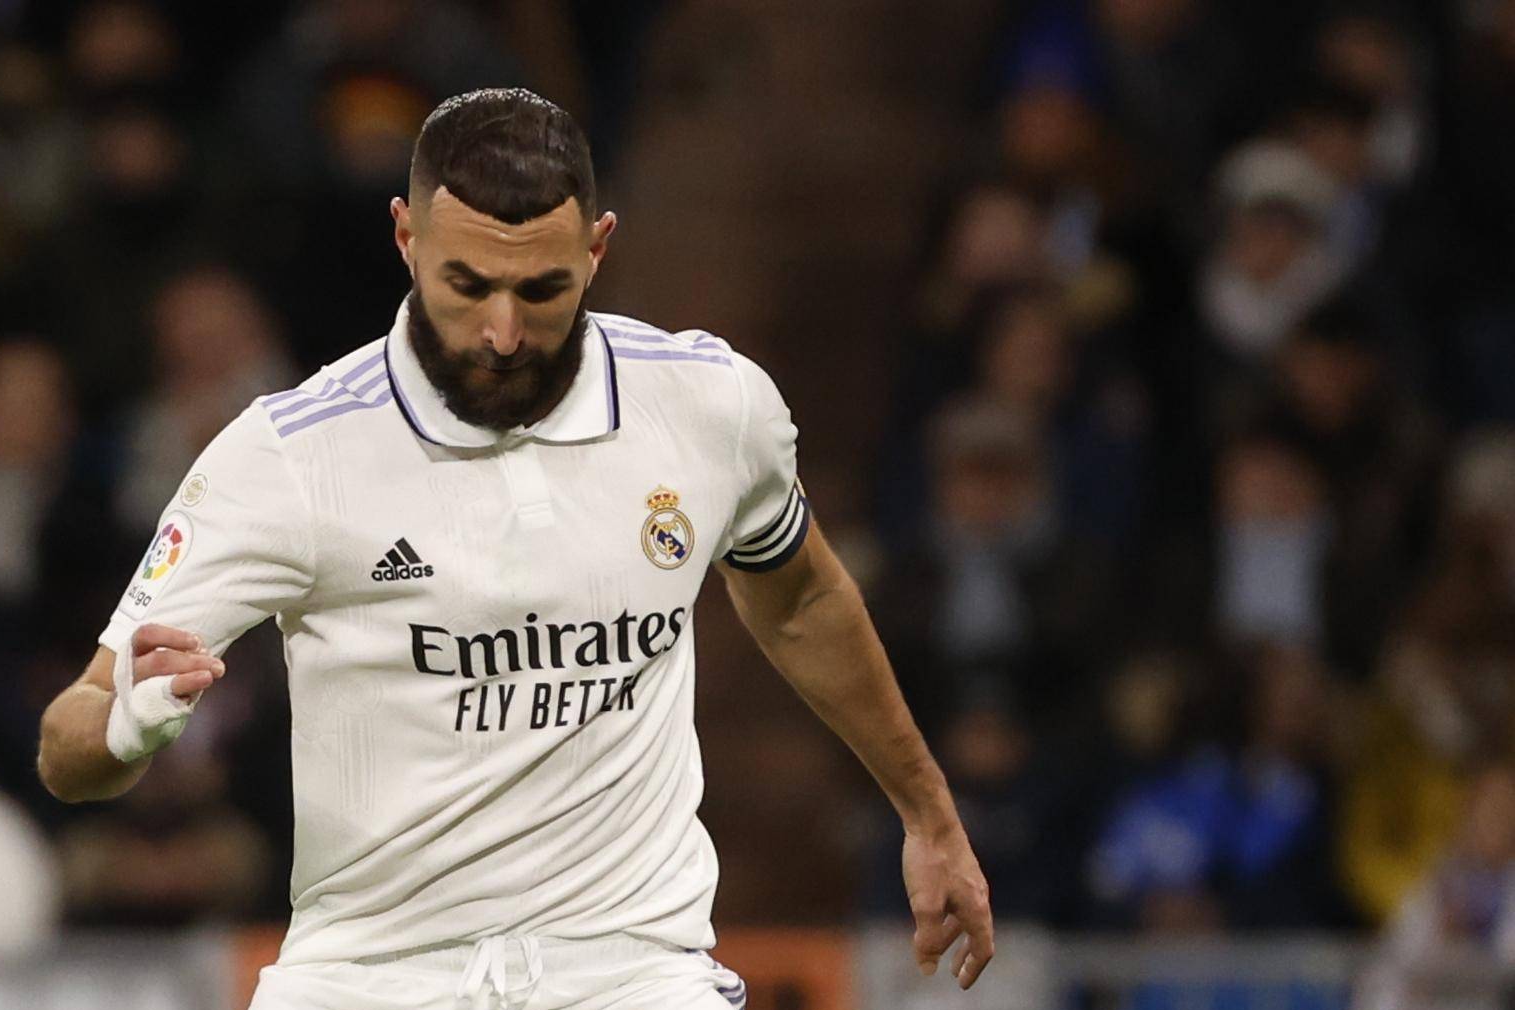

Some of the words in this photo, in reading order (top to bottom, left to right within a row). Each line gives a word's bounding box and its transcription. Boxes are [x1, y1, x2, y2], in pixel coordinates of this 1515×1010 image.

[371, 561, 435, 582] adidas
[407, 606, 686, 679] Emirates
[454, 683, 516, 731] FLY
